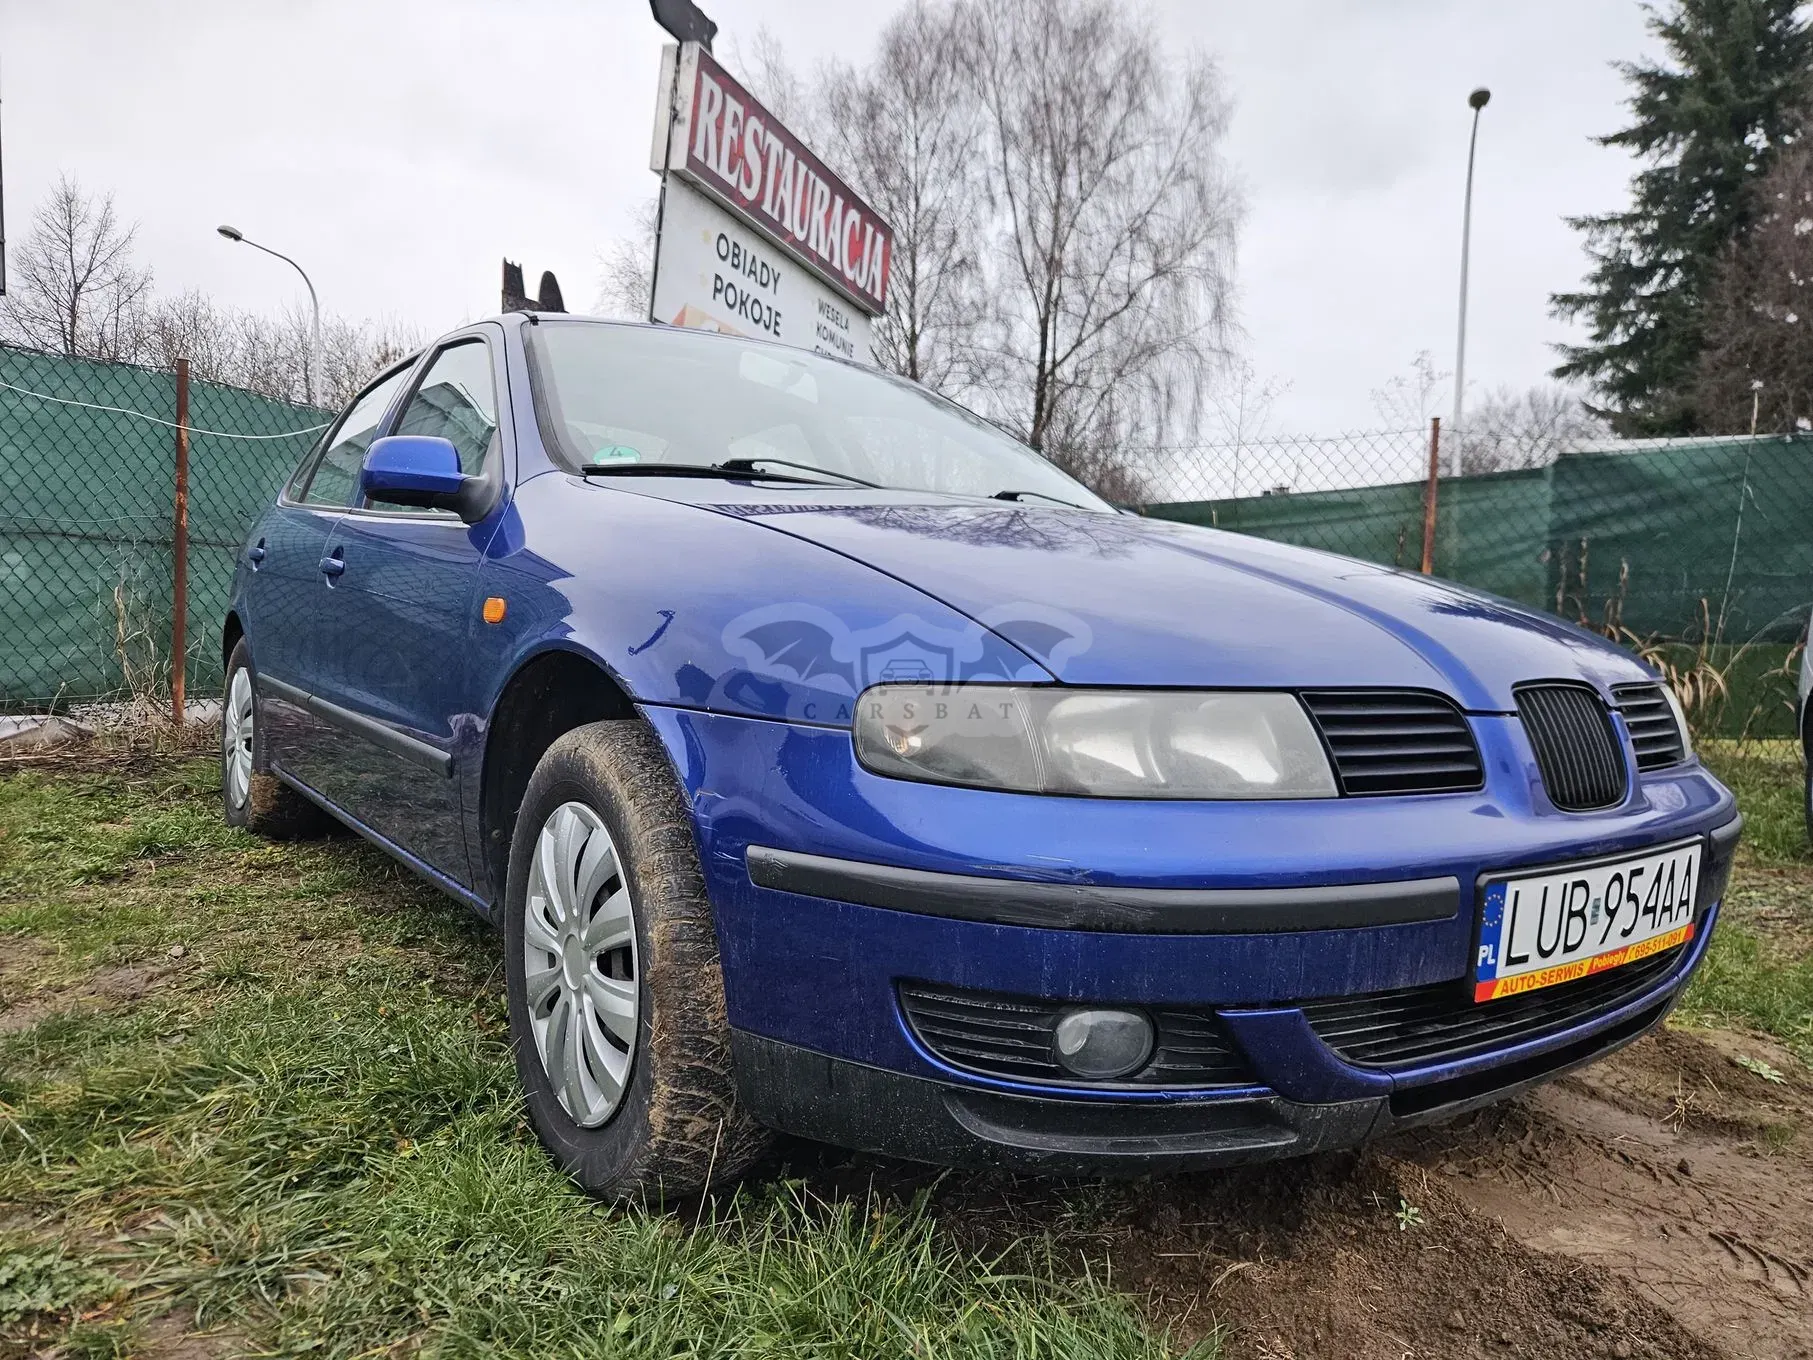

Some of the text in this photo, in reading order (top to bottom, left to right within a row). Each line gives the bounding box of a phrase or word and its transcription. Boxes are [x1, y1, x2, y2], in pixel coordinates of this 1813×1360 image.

[693, 71, 884, 302] RESTAURACJA
[716, 233, 781, 296] OBIADY
[713, 273, 781, 338] POKOJE
[818, 298, 849, 333] WESELA
[816, 321, 854, 358] KOMUNIE
[1505, 854, 1692, 967] LUB 954AA
[1477, 944, 1495, 967] PL
[1500, 962, 1584, 996] AUTO-SERWIS
